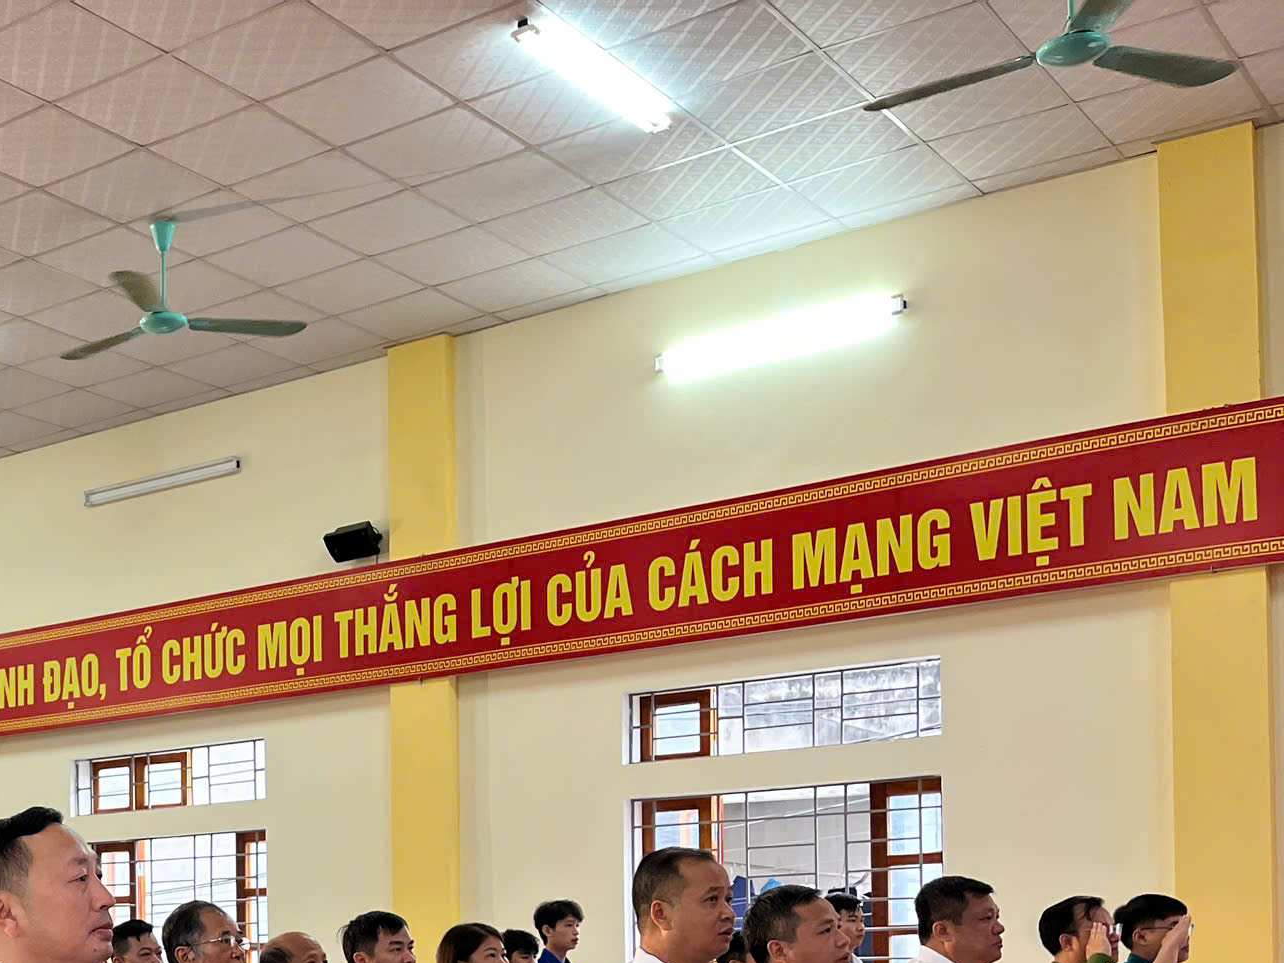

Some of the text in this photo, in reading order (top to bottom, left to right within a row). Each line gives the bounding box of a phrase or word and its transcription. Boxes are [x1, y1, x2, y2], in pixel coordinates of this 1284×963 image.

[42, 652, 107, 710] ĐẠO,
[116, 626, 152, 691] TỔ
[162, 624, 246, 684] CHỨC
[258, 614, 323, 677] MỌI
[334, 584, 457, 660] THẮNG
[471, 576, 532, 646] LỢI
[547, 551, 634, 628] CỦA
[648, 538, 773, 612] CÁCH
[792, 508, 951, 594] MẠNG
[970, 477, 1093, 567] VIỆT
[1112, 456, 1259, 541] NAM
